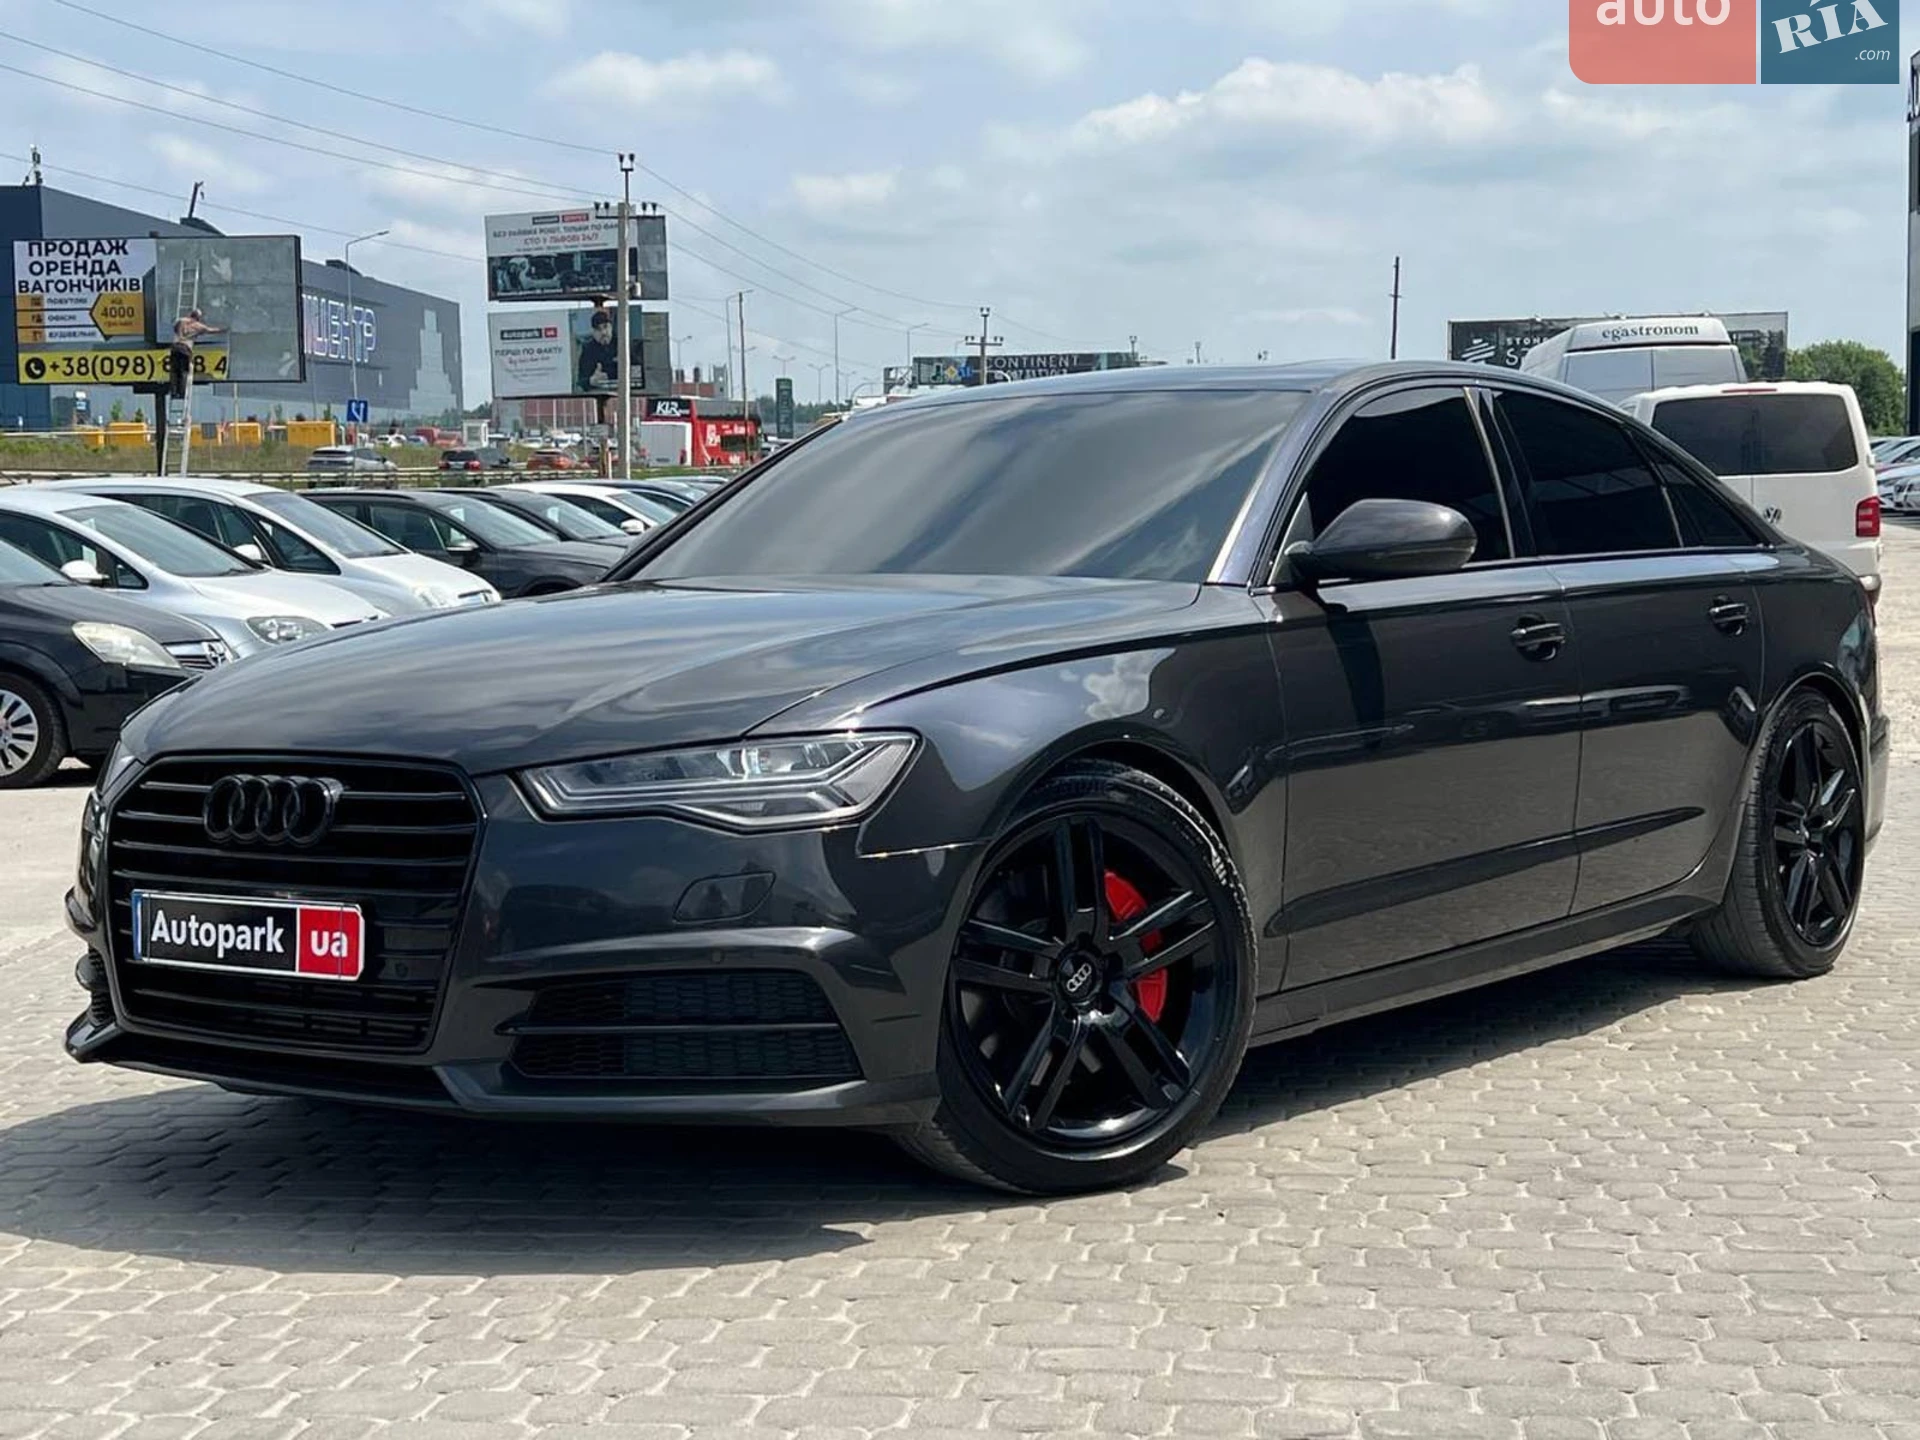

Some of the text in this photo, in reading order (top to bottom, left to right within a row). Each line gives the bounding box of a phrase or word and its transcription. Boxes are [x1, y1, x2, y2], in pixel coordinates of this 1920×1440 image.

[28, 240, 129, 259] ПРОДАЖ
[28, 260, 122, 278] ОРЕНДА
[18, 278, 140, 294] ВАГОНЧИКІВ
[101, 306, 136, 318] 4000
[1602, 325, 1699, 341] egastronom
[151, 909, 348, 959] Autopark ua
